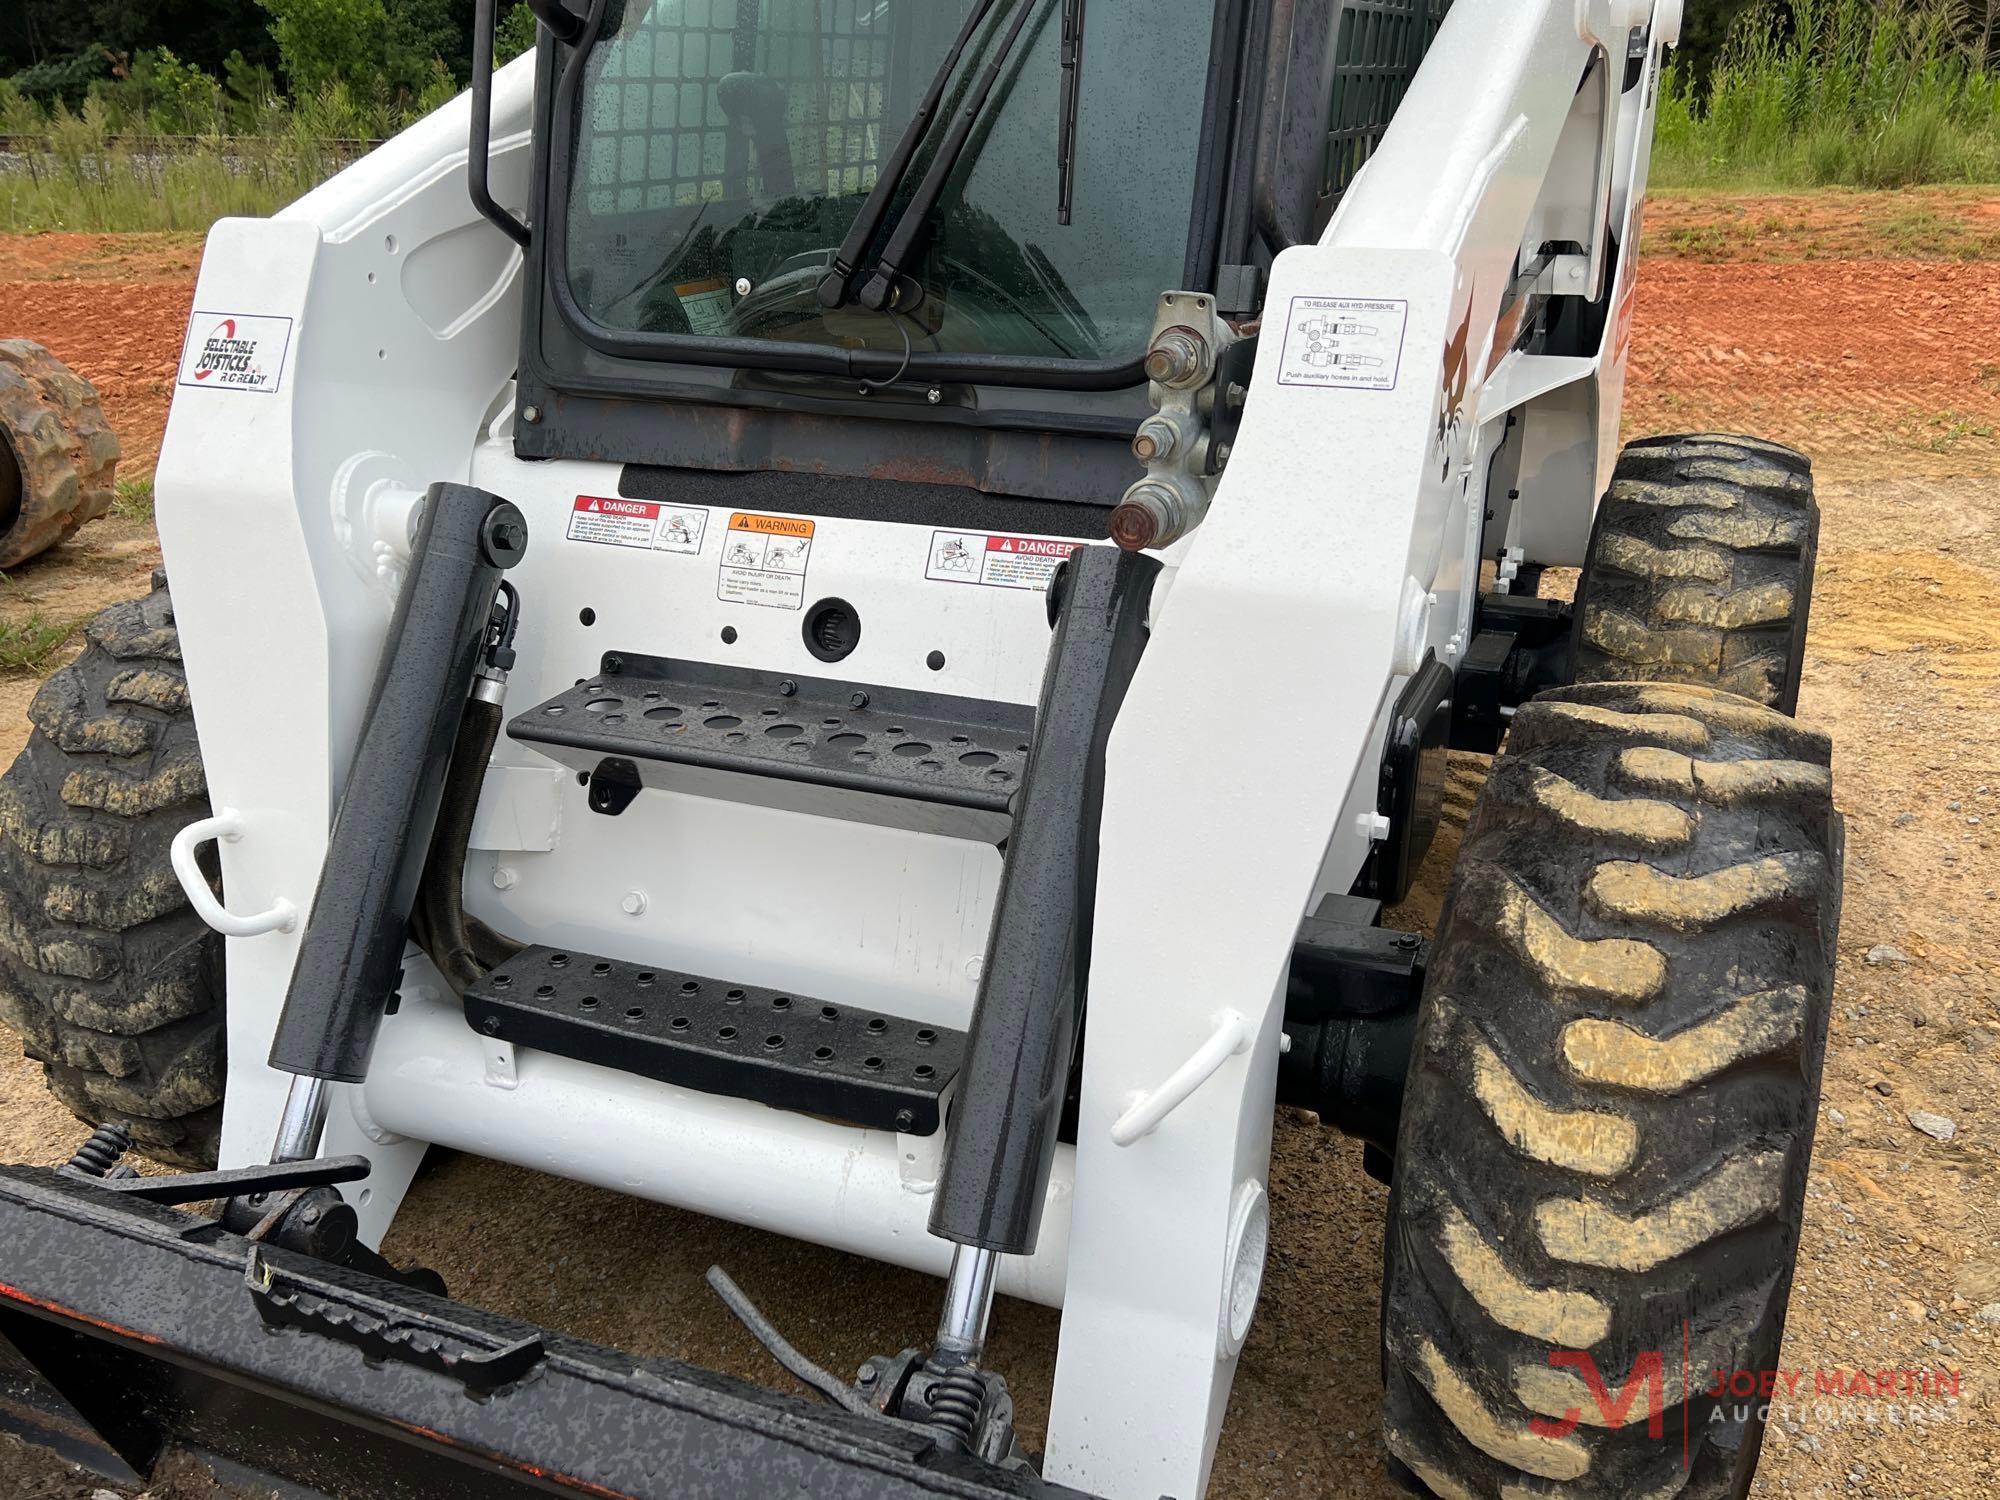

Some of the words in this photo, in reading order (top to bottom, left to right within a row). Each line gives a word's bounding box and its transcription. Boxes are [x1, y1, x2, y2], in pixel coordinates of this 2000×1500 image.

[204, 338, 257, 354] SELECTABLE
[196, 352, 252, 372] JOYSTICKS
[237, 373, 267, 385] READY
[603, 502, 647, 514] DANGER
[755, 519, 807, 533] WARNING
